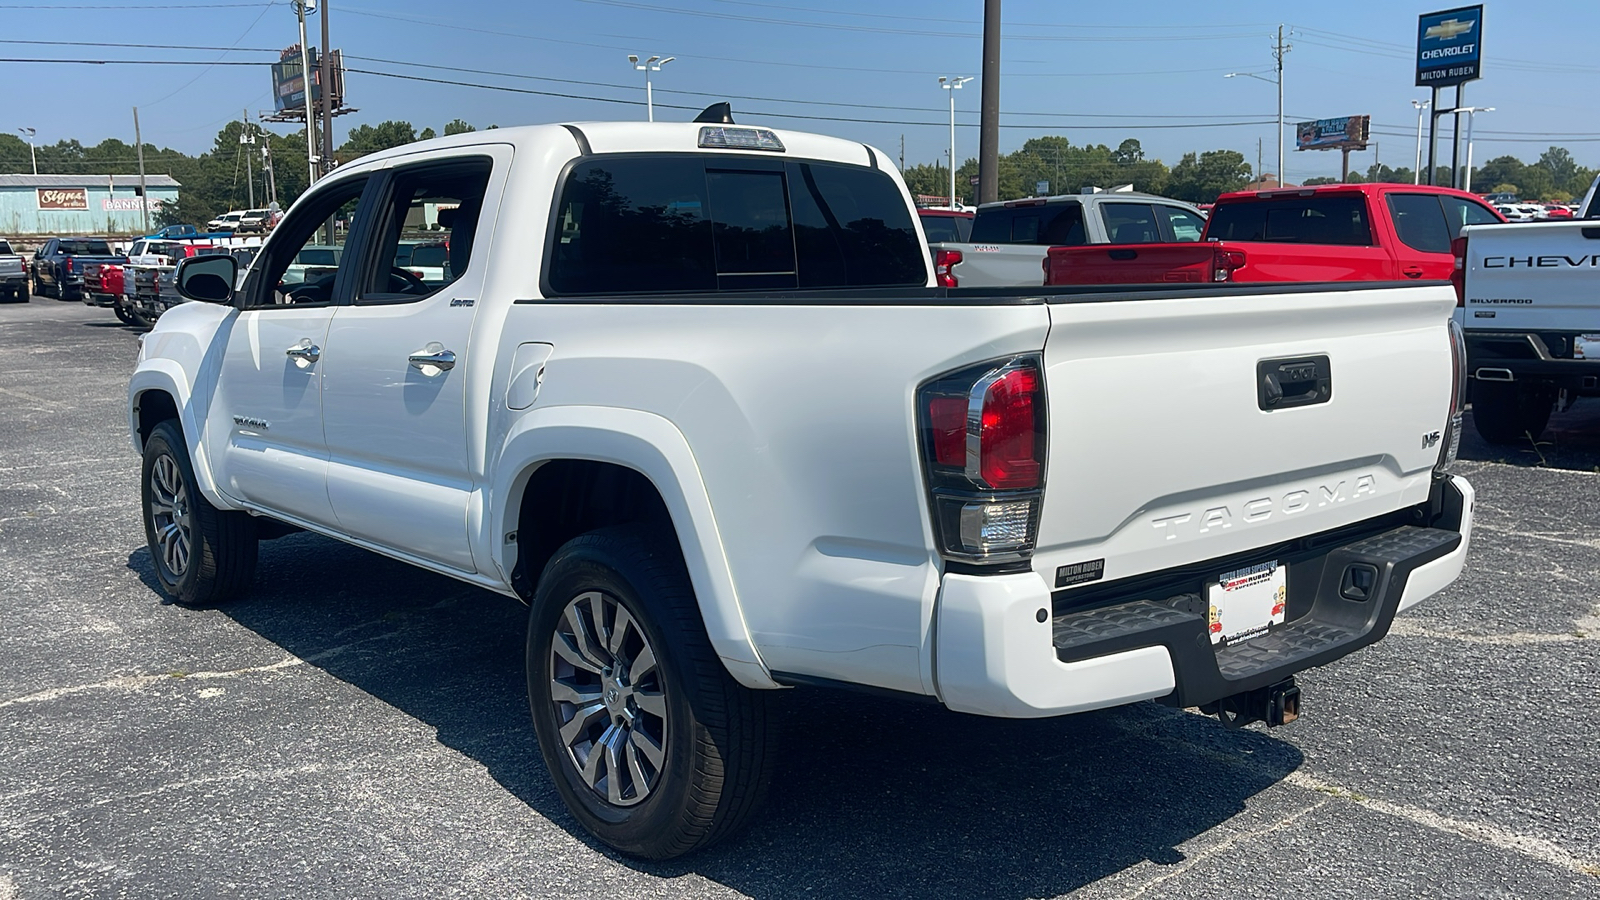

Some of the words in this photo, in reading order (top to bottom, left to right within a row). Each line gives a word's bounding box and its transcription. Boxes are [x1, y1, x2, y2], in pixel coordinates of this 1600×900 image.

[1421, 44, 1475, 59] CHEVROLET
[1420, 70, 1446, 80] MILTON
[1448, 66, 1474, 77] RUBEN
[41, 190, 83, 204] Signs
[1152, 474, 1376, 540] TACOMA
[1059, 564, 1083, 578] MILTON
[1082, 560, 1104, 573] RUBEN
